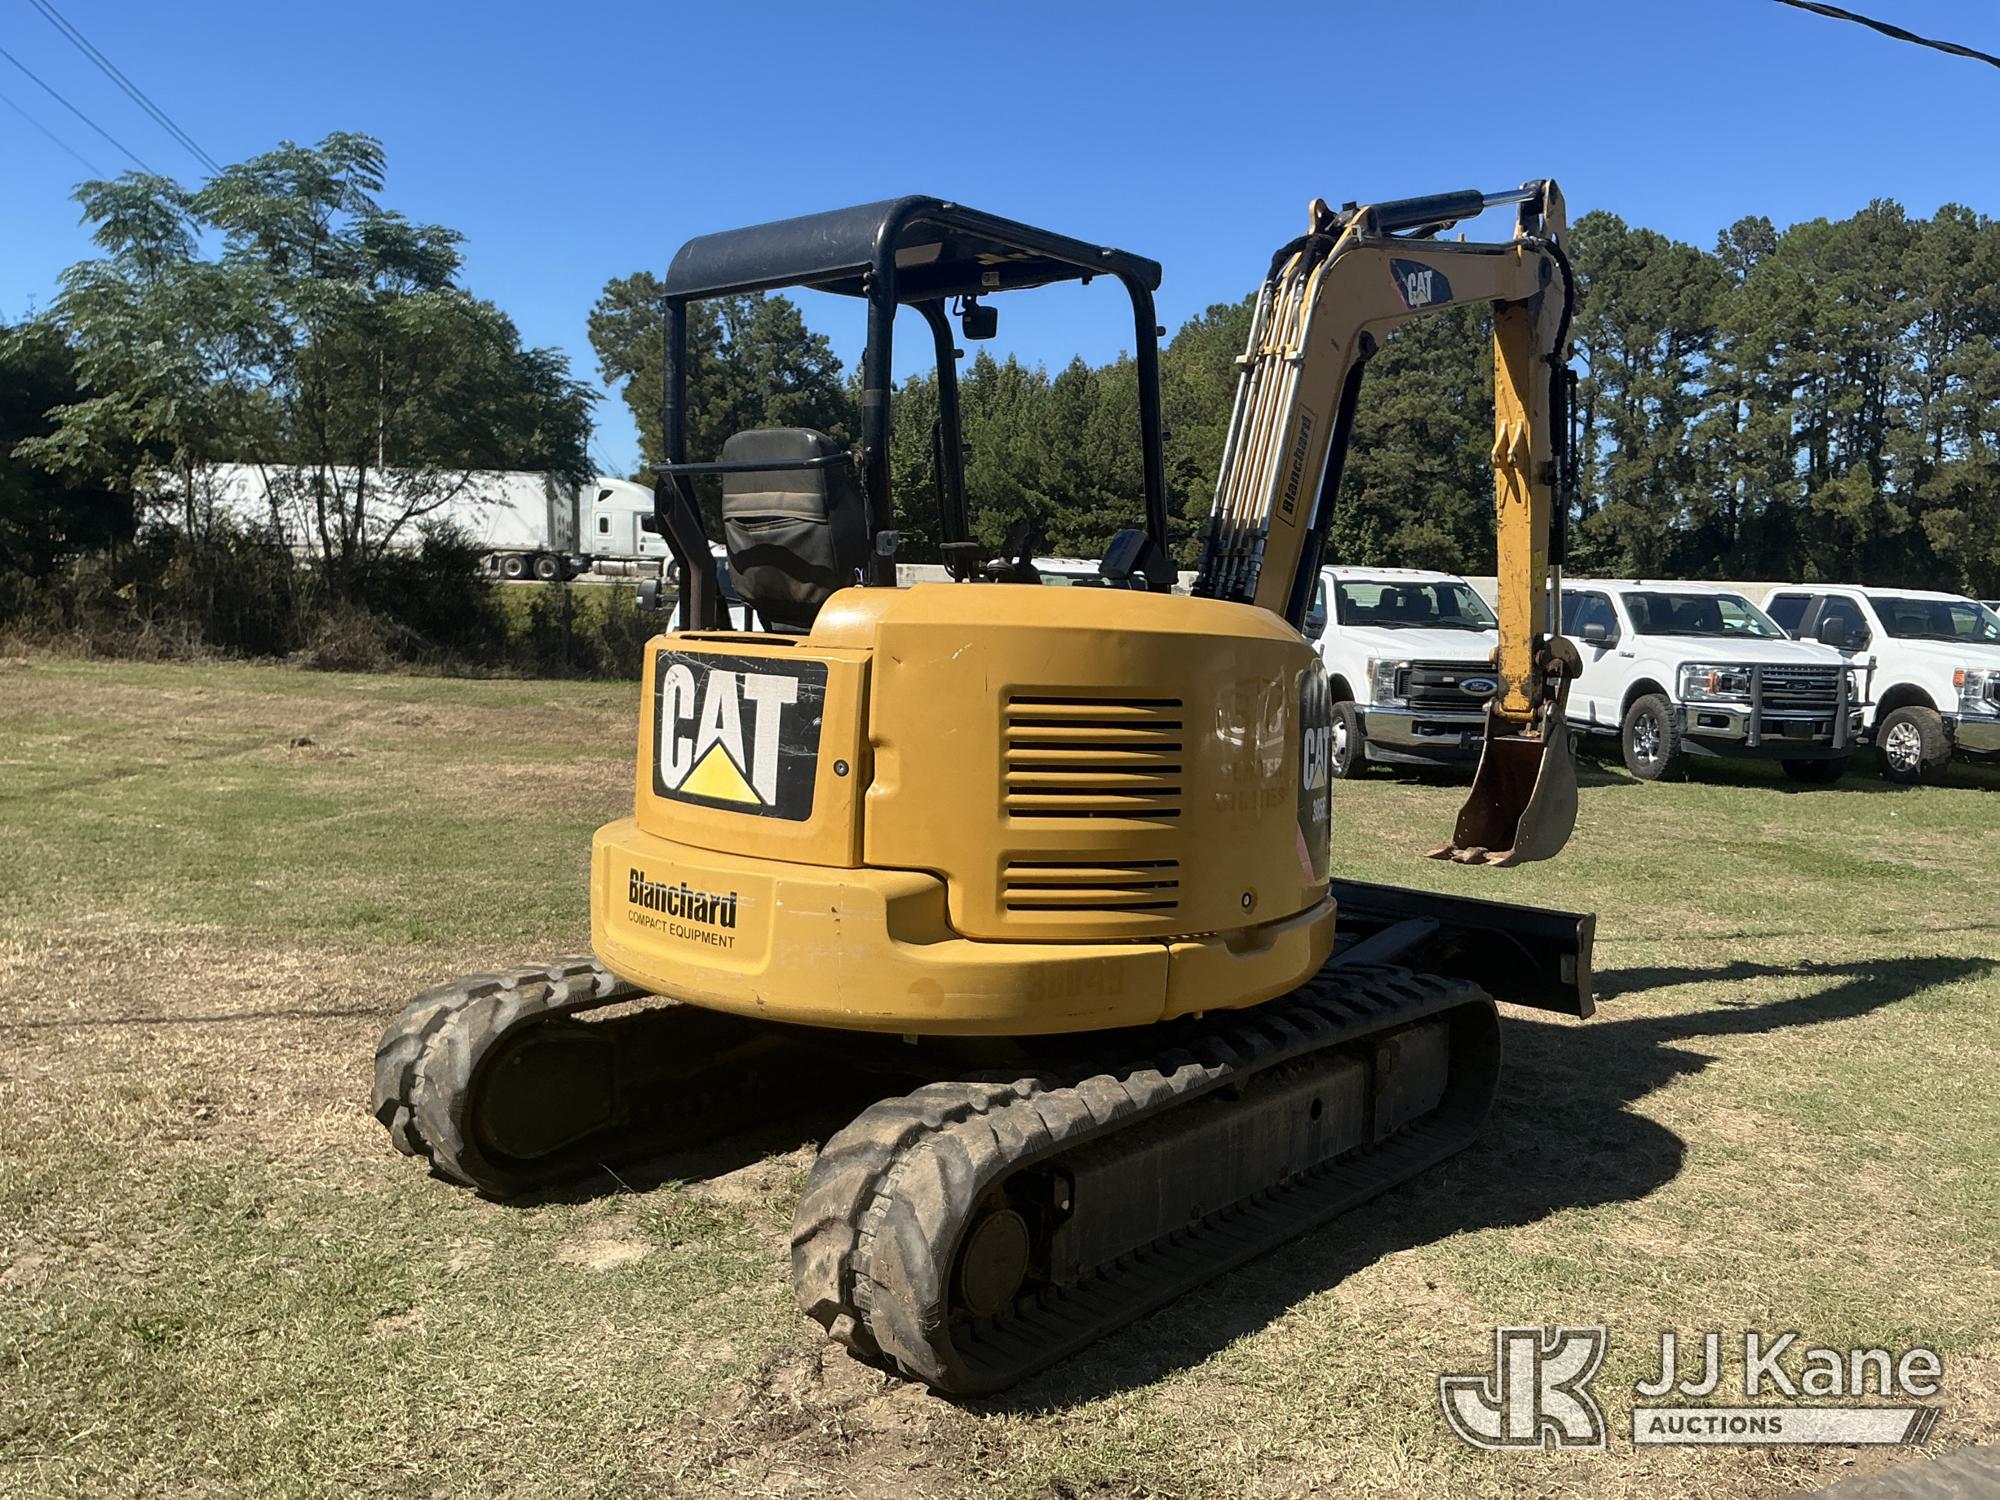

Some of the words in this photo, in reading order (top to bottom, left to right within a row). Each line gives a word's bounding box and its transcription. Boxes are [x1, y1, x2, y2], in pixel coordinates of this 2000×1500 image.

[1407, 270, 1432, 305] CAT
[660, 663, 799, 806] CAT
[1303, 726, 1330, 790] CAT
[628, 867, 738, 929] Blanchard
[628, 909, 668, 933] COMPACT
[669, 923, 736, 949] EQUIPMENT
